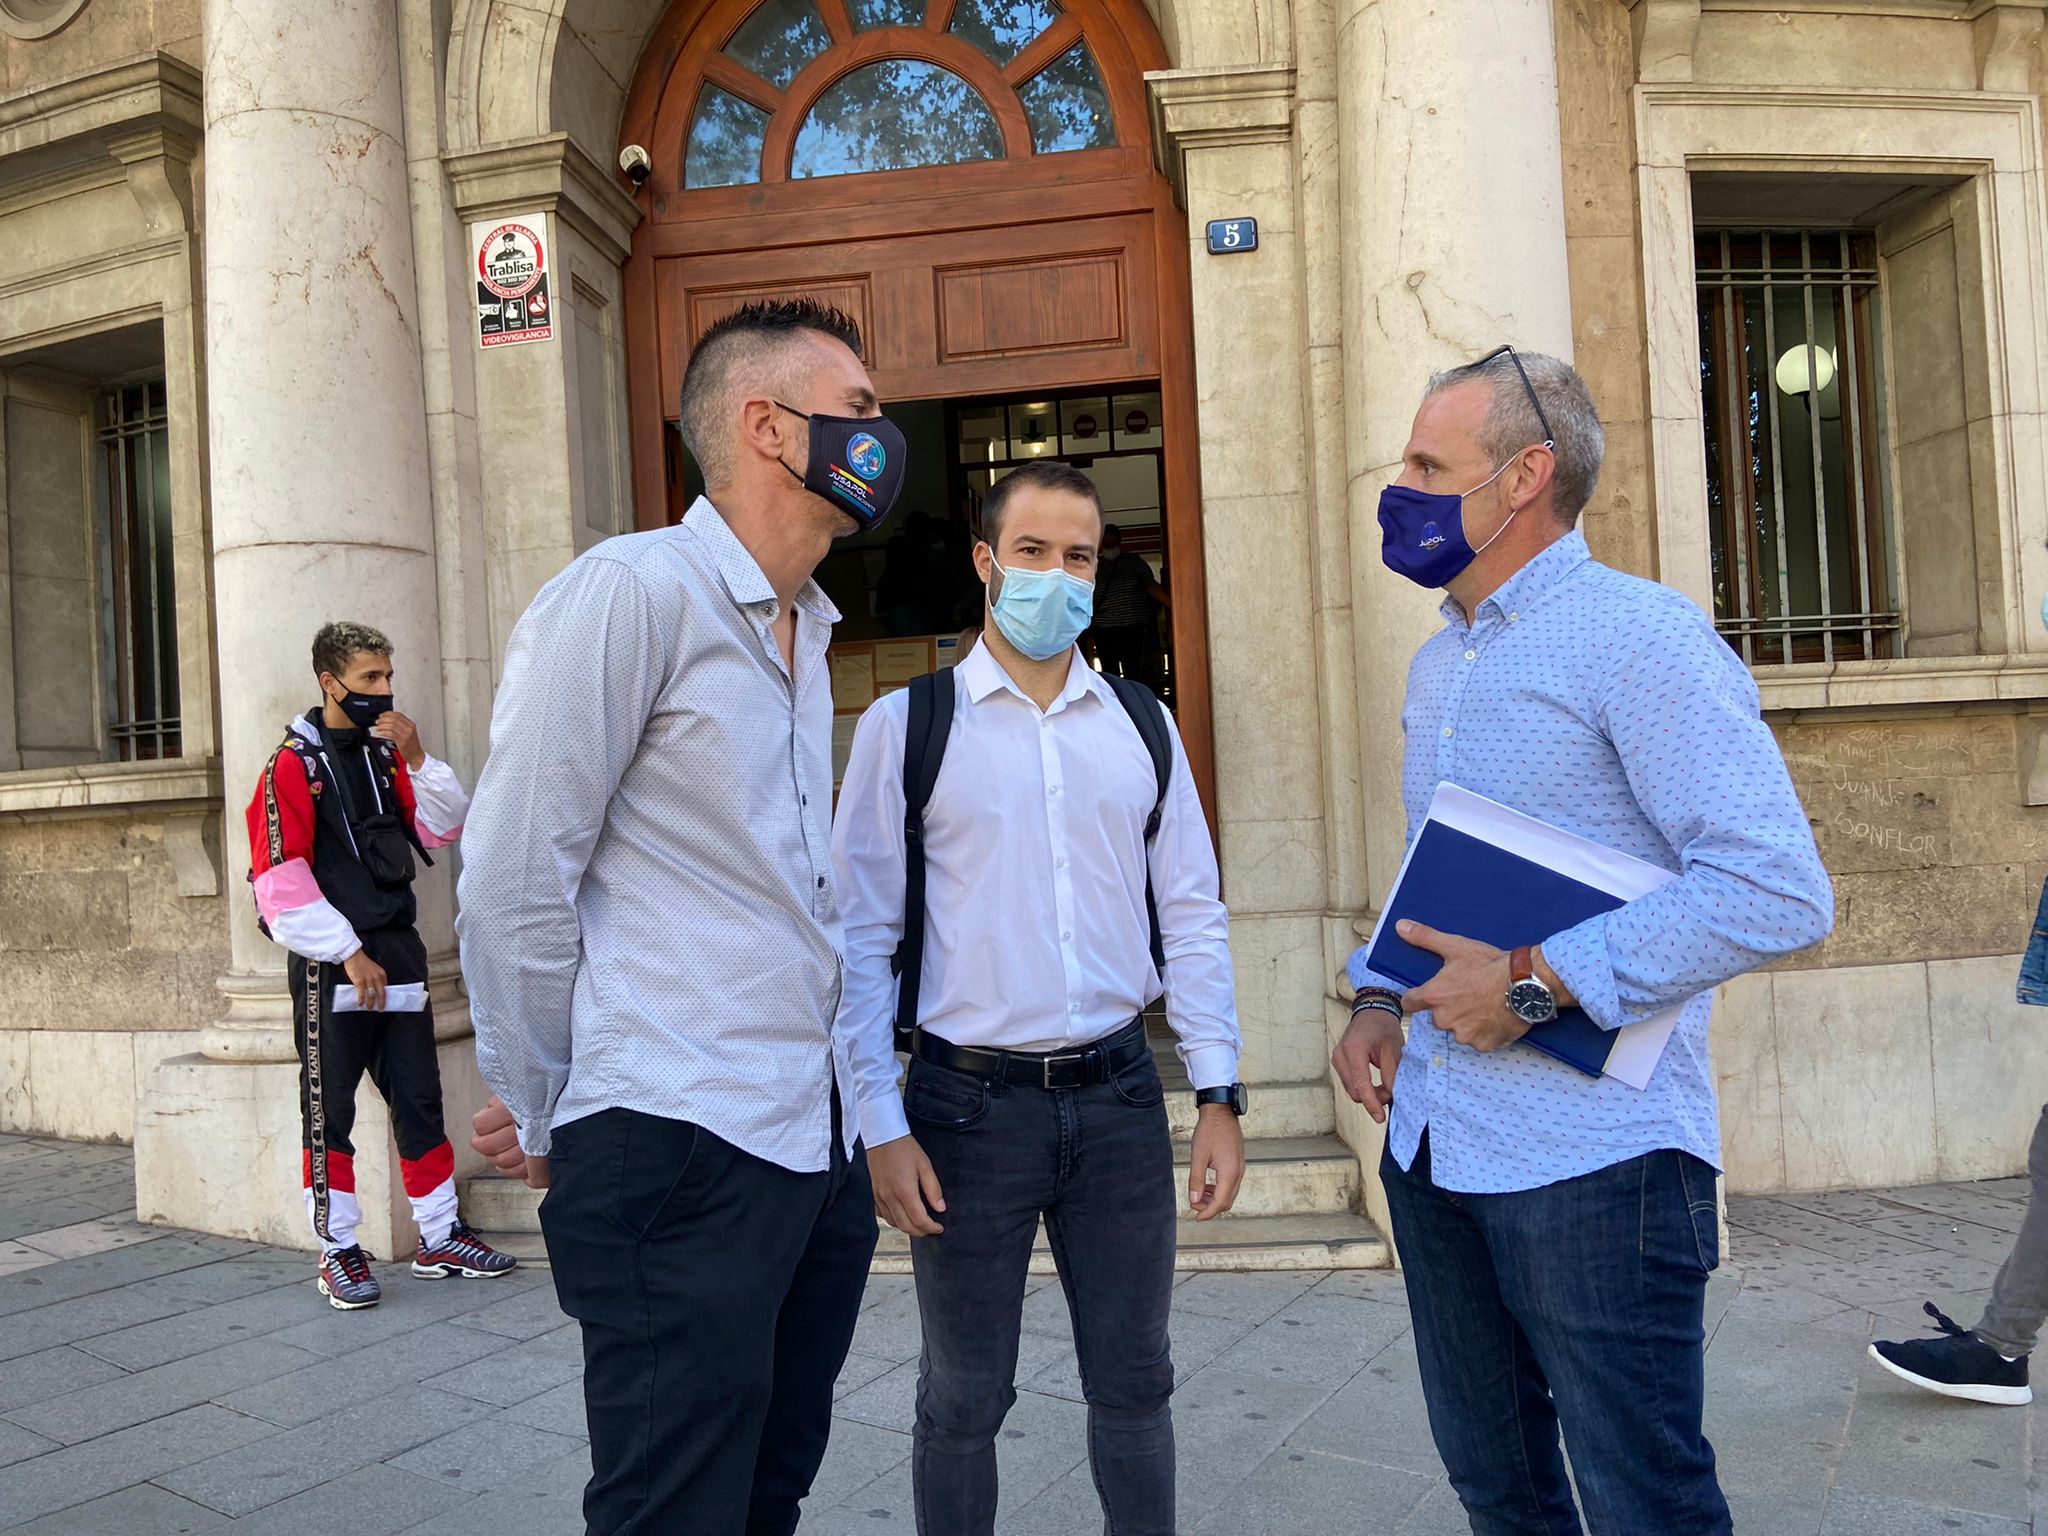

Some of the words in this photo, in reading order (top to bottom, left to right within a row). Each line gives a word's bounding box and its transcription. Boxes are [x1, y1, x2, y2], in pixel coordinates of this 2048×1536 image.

[482, 226, 504, 252] CENTRAL
[515, 226, 538, 245] ALARMA
[1223, 223, 1240, 247] 5
[482, 273, 511, 296] VIGILANCIA
[510, 267, 542, 296] PERMANENTE
[487, 260, 534, 277] Trablisa
[483, 329, 550, 345] VIDEOVIGILANCIA
[829, 471, 867, 499] JUSAPOL
[309, 990, 319, 1022] KANI
[309, 1046, 319, 1078] KANI
[312, 1101, 323, 1132] KANI
[314, 1153, 325, 1183] KANI
